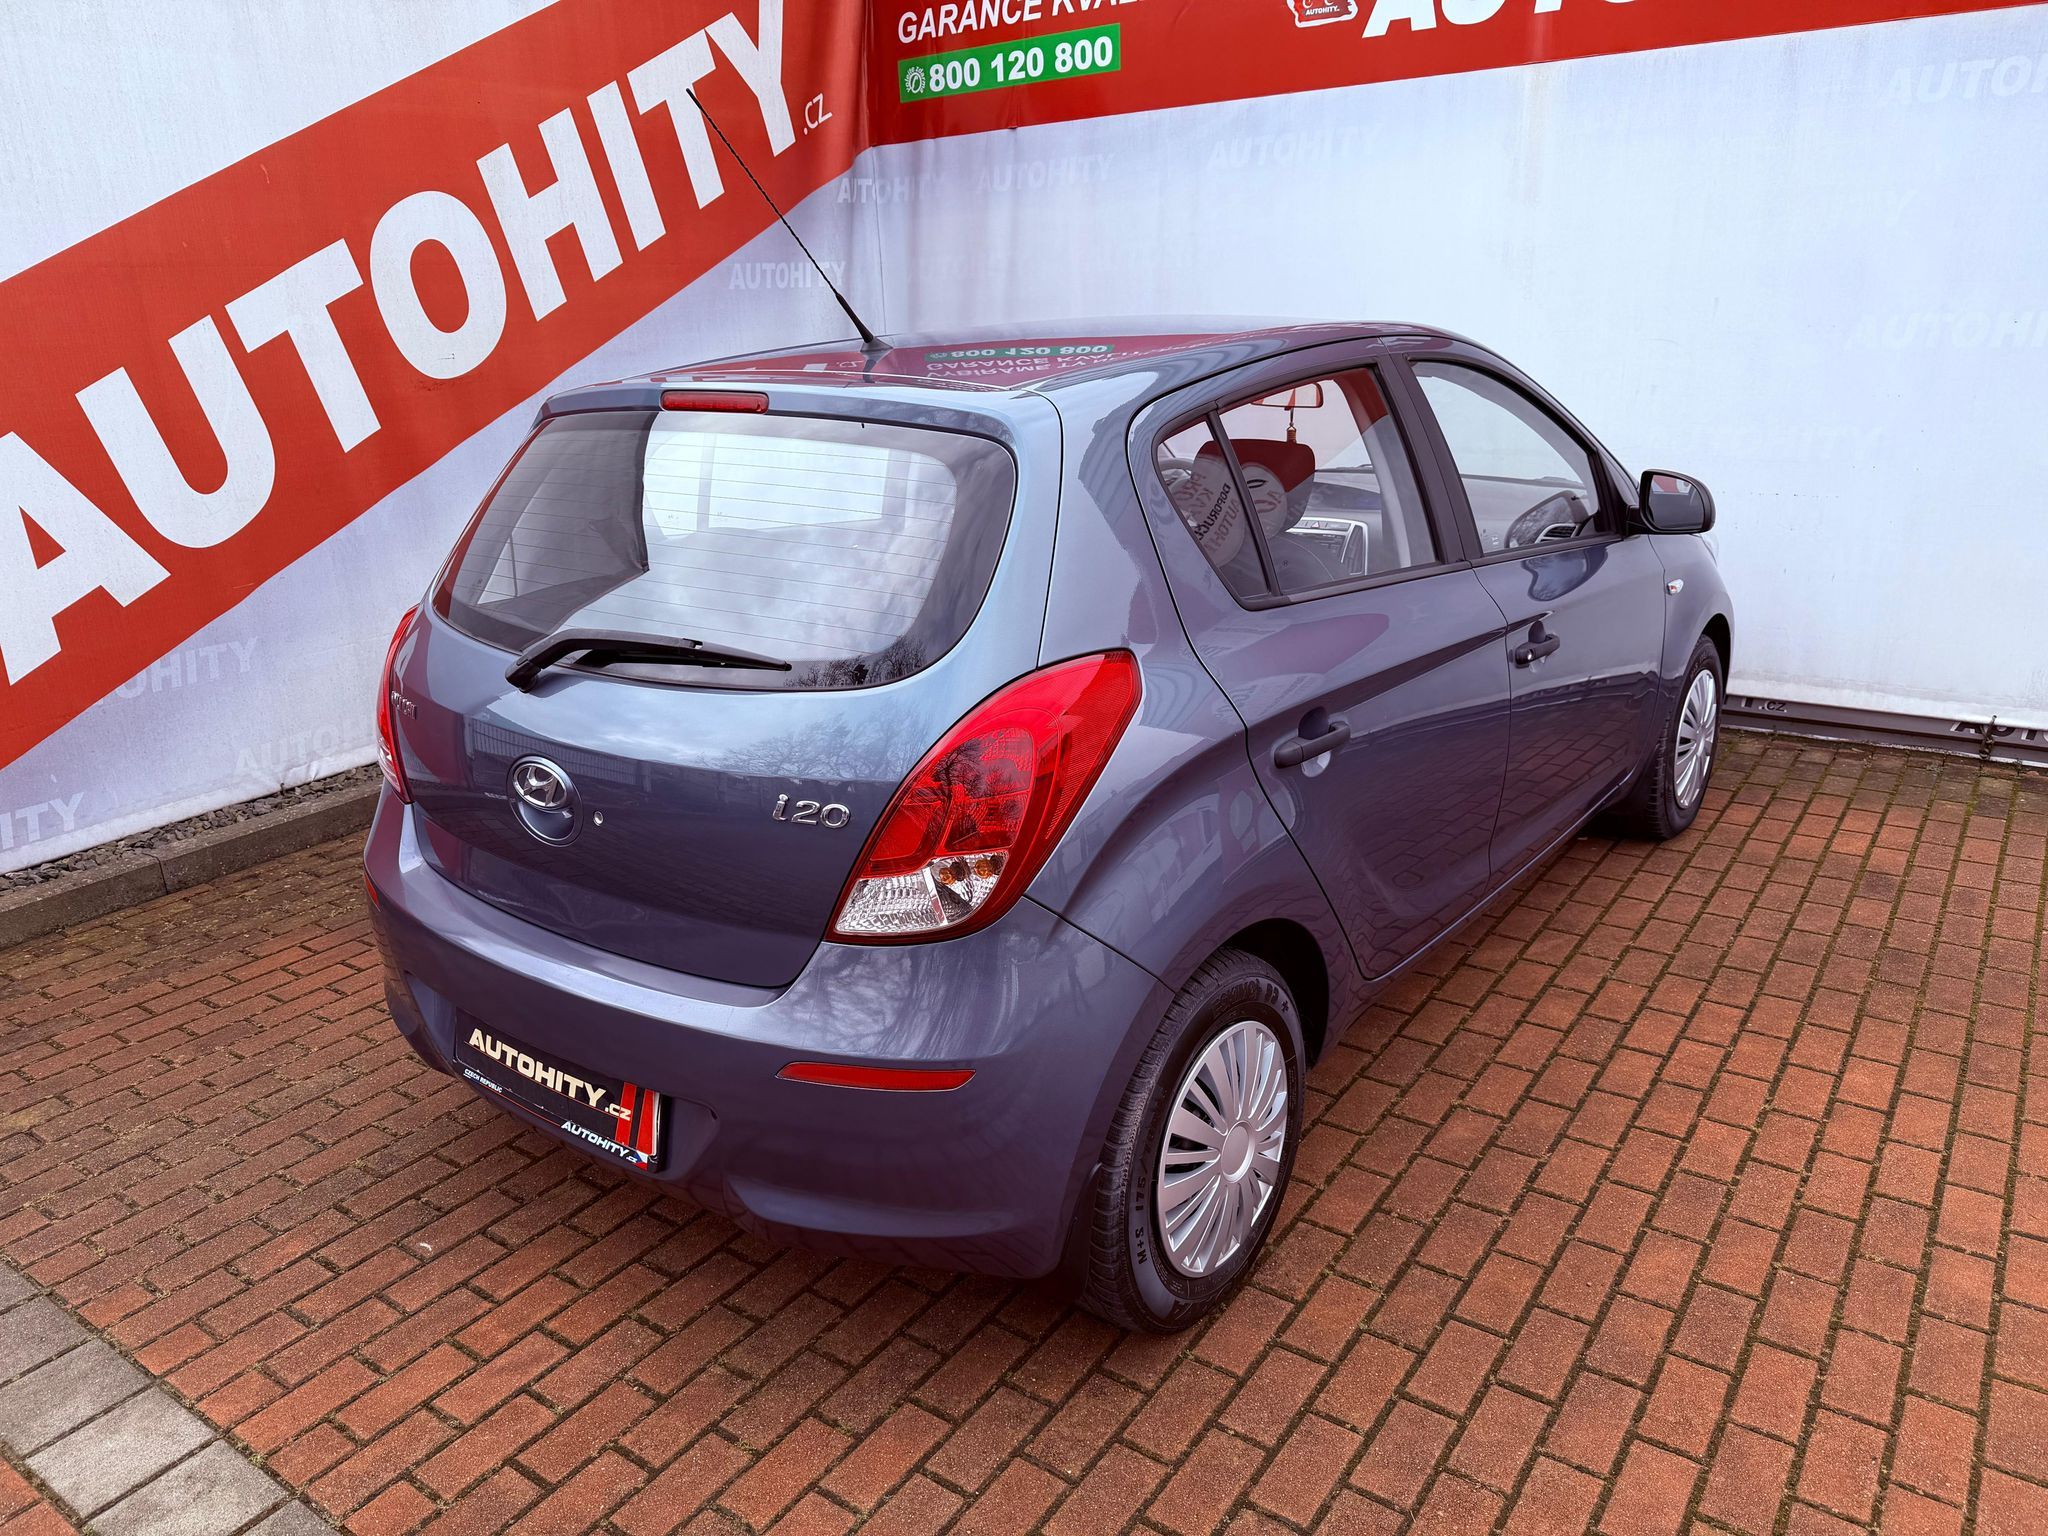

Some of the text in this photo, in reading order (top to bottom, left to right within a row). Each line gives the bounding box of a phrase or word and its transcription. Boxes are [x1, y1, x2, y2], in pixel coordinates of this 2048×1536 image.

[898, 0, 1042, 44] GARANCE
[929, 36, 1113, 92] 800 120 800
[1207, 126, 1381, 169] AUTOHITY
[975, 152, 1117, 194] AUTOHITY
[729, 261, 846, 290] AUTOHITY
[772, 793, 851, 829] i20
